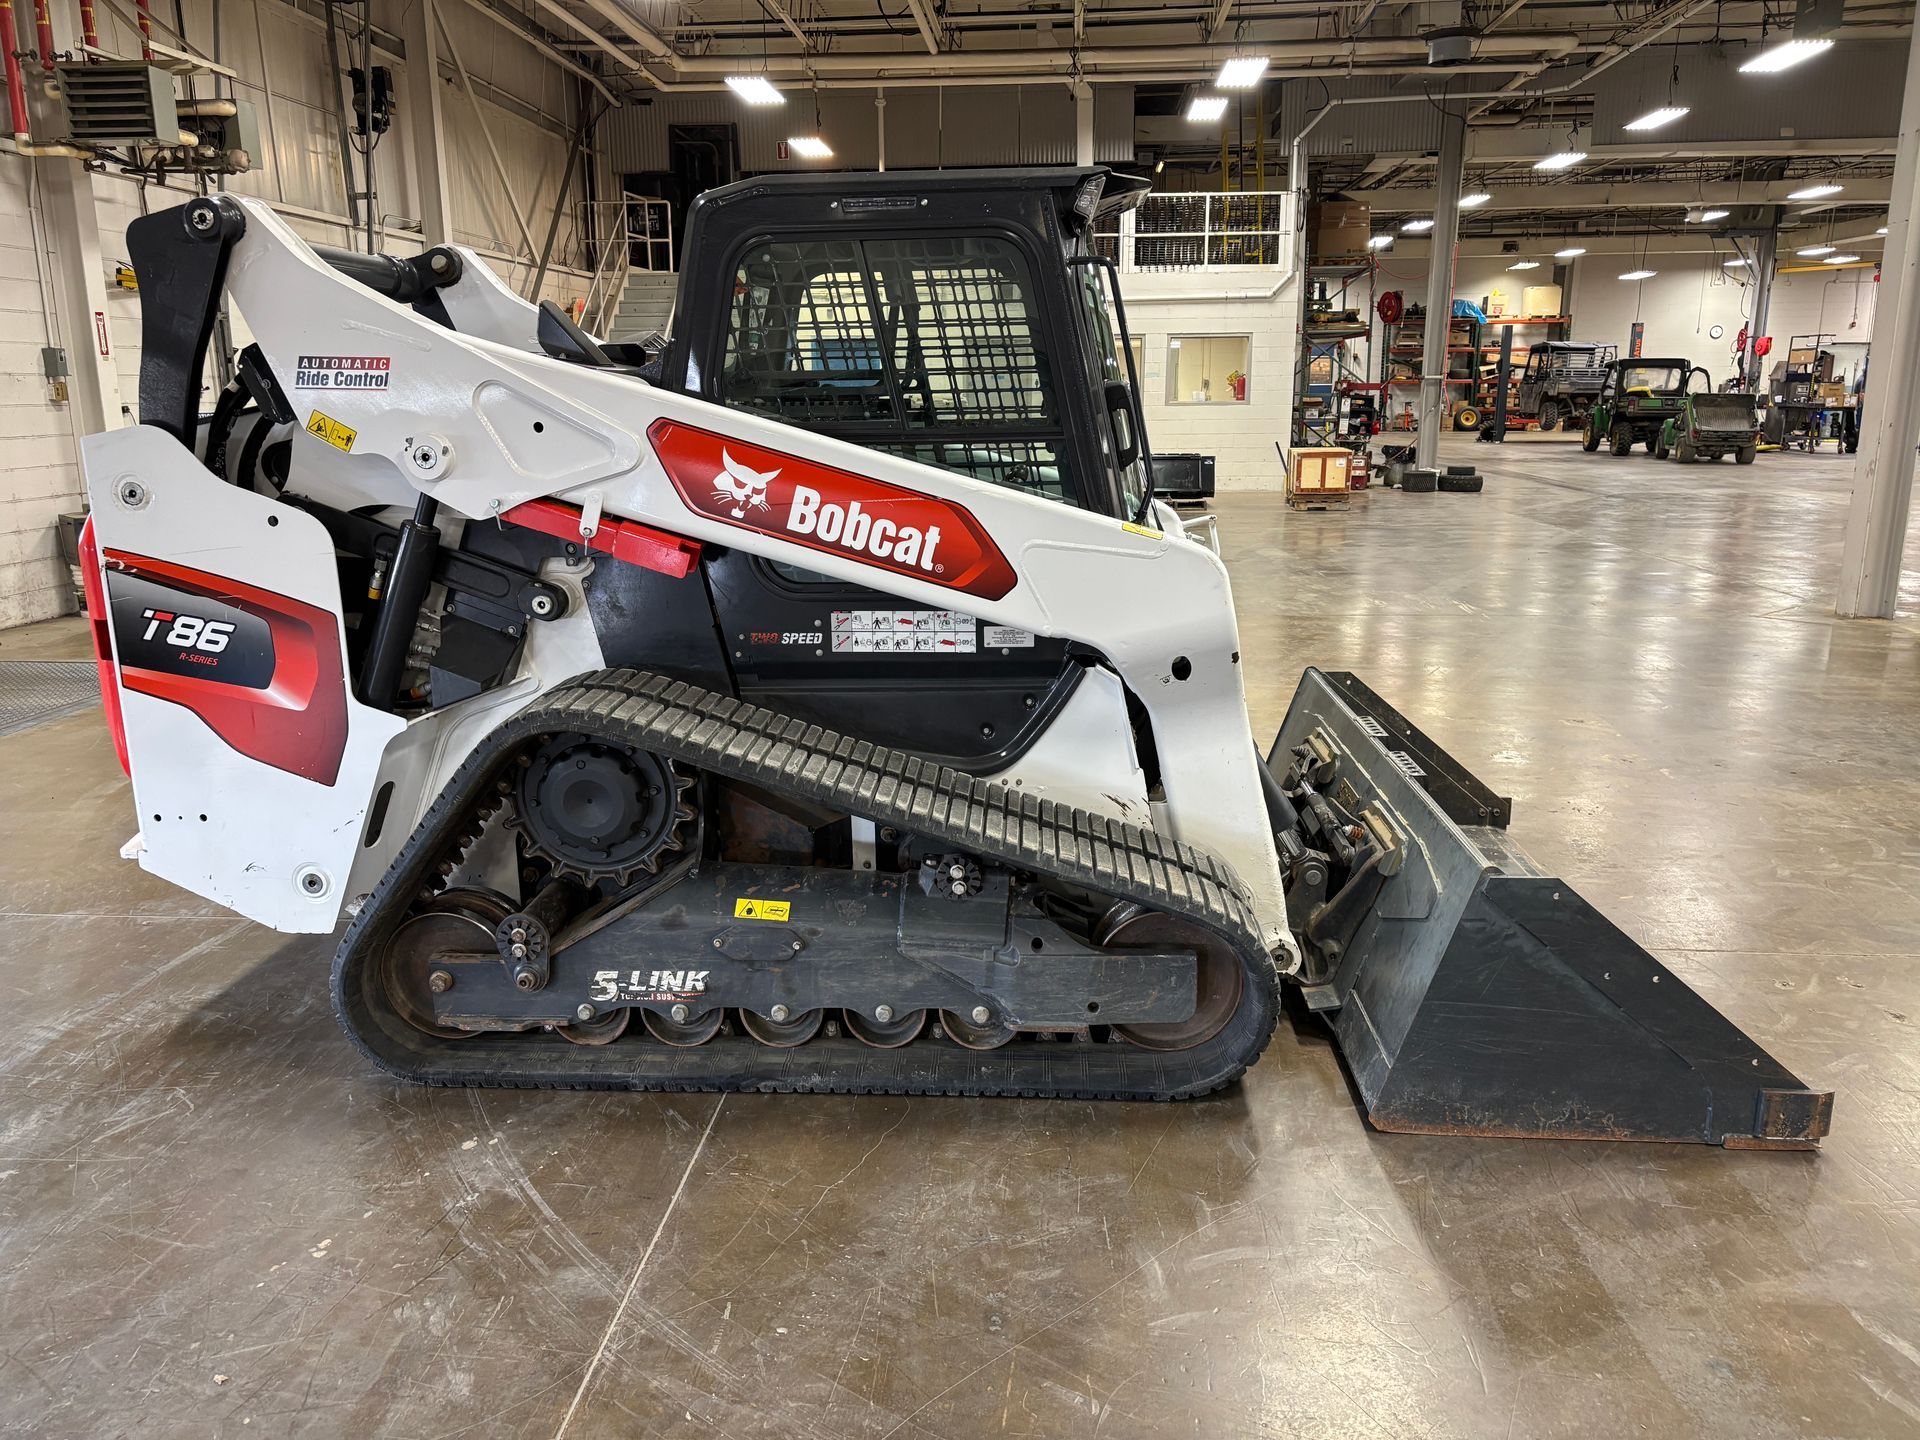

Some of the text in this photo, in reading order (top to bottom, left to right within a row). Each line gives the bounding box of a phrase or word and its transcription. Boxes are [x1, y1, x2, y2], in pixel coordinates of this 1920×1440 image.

[301, 358, 387, 369] AUTOMATIC
[295, 370, 389, 387] Ride Control
[786, 484, 941, 571] Bobcat
[142, 608, 236, 653] T86
[750, 632, 823, 645] TWO SPEED
[179, 652, 219, 666] R-SERIES
[590, 970, 710, 1002] 5-LINK
